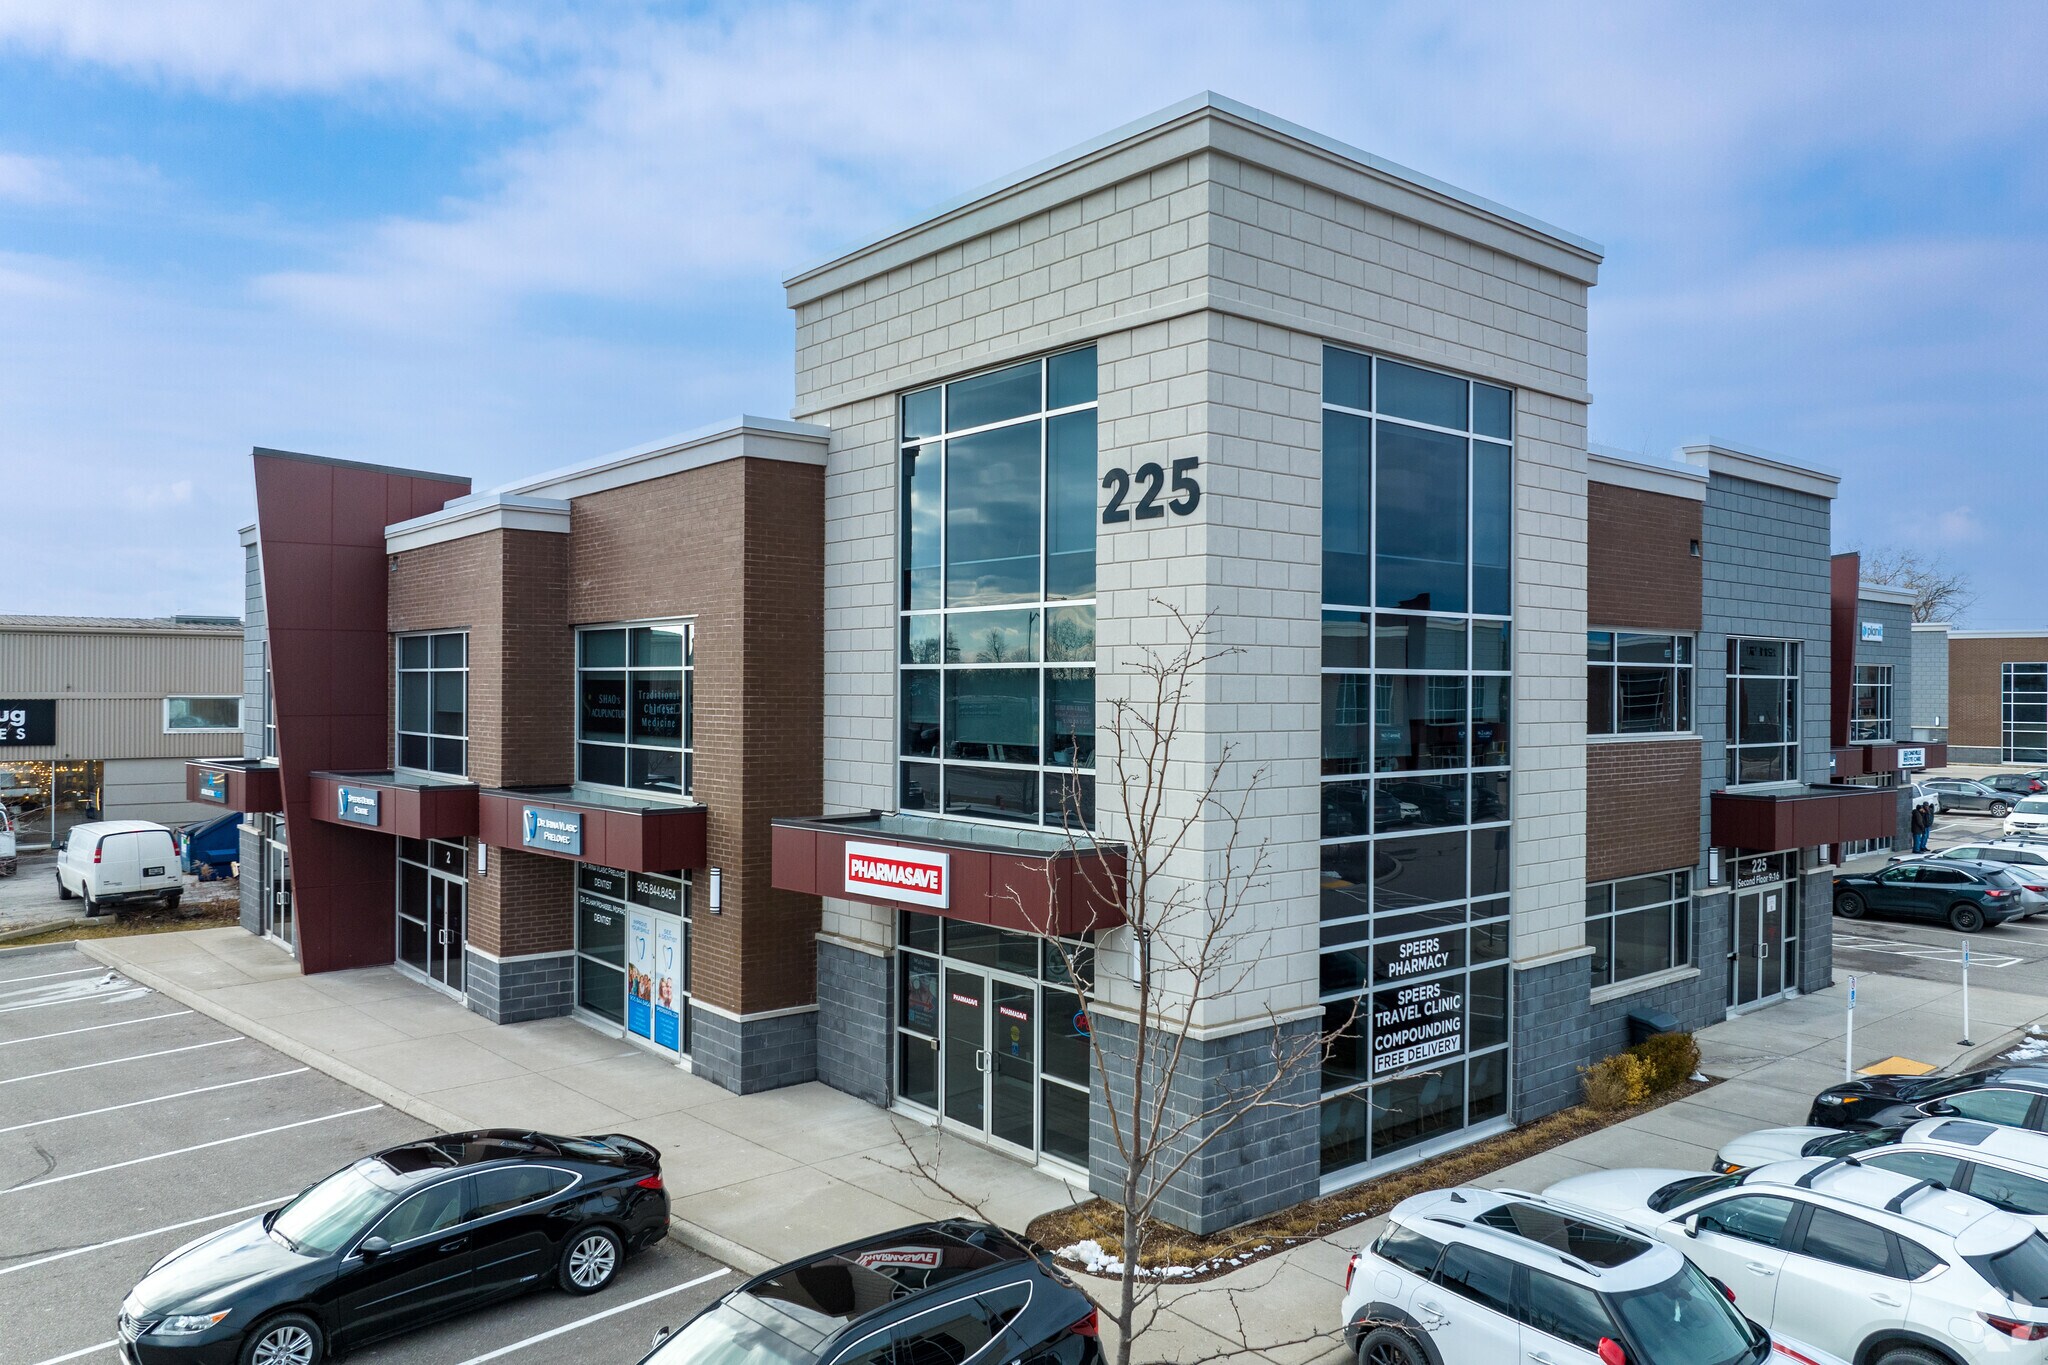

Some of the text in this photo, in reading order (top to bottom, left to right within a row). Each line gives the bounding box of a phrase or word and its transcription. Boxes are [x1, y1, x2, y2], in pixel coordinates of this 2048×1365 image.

[1102, 456, 1200, 524] 225
[638, 690, 680, 700] Traditional
[591, 708, 625, 718] ACUPUNCTUR
[643, 703, 674, 714] Chinese
[641, 717, 676, 727] Medicine
[544, 831, 570, 844] PRELOVEC
[446, 851, 451, 864] 2
[1752, 858, 1767, 873] 225
[851, 859, 938, 889] PHARMASAVE
[594, 878, 612, 890] DENTIST
[1738, 876, 1756, 888] Second
[1756, 875, 1769, 884] Floor
[637, 880, 676, 900] 905.844.8454
[594, 913, 612, 926] DENTIST
[1399, 938, 1440, 958] SPEERS
[1389, 952, 1449, 977] PHARMACY
[953, 994, 978, 1006] PHARMASAVE
[1398, 983, 1440, 1005] SPEERS
[1000, 1007, 1027, 1020] PHARMASAVE
[1375, 995, 1460, 1027] TRAVEL CLINIC
[1375, 1017, 1460, 1051] COMPOUNDING
[1377, 1037, 1458, 1070] FREE DELIVERY
